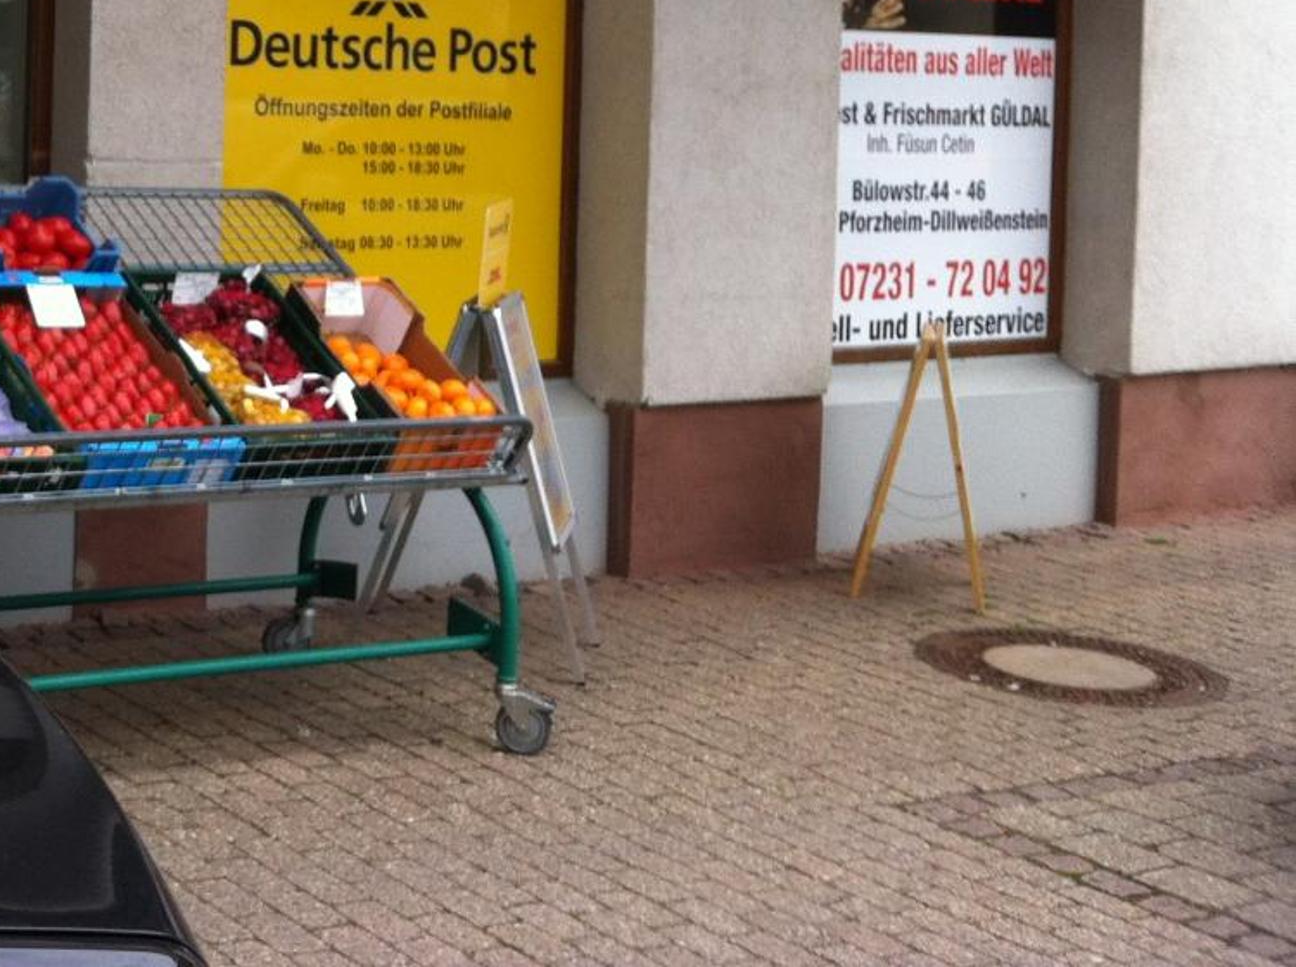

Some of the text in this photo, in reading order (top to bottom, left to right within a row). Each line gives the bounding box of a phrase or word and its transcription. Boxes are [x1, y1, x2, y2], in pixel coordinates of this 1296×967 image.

[230, 19, 537, 75] Deutsche Post
[924, 51, 958, 75] aus
[965, 46, 1007, 76] aller
[1013, 49, 1054, 79] Welt
[254, 93, 513, 121] Öffnungszeiten der Postfiliale
[839, 99, 1050, 128] st & Frischmarkt GÜLDAL
[443, 143, 465, 156] Uhr
[867, 135, 893, 154] Inh.
[897, 133, 937, 154] Füsun
[443, 162, 465, 176] Uhr
[966, 179, 986, 201] 46
[301, 197, 345, 215] Freitag
[442, 199, 464, 213] Uhr
[839, 209, 1048, 232] Pforzheim-Dillweißenstein
[441, 236, 463, 251] Uhr
[839, 261, 916, 302] 07231
[946, 261, 974, 298] 72
[982, 260, 1011, 297] 04
[1019, 258, 1046, 294] 92
[869, 312, 908, 340] und
